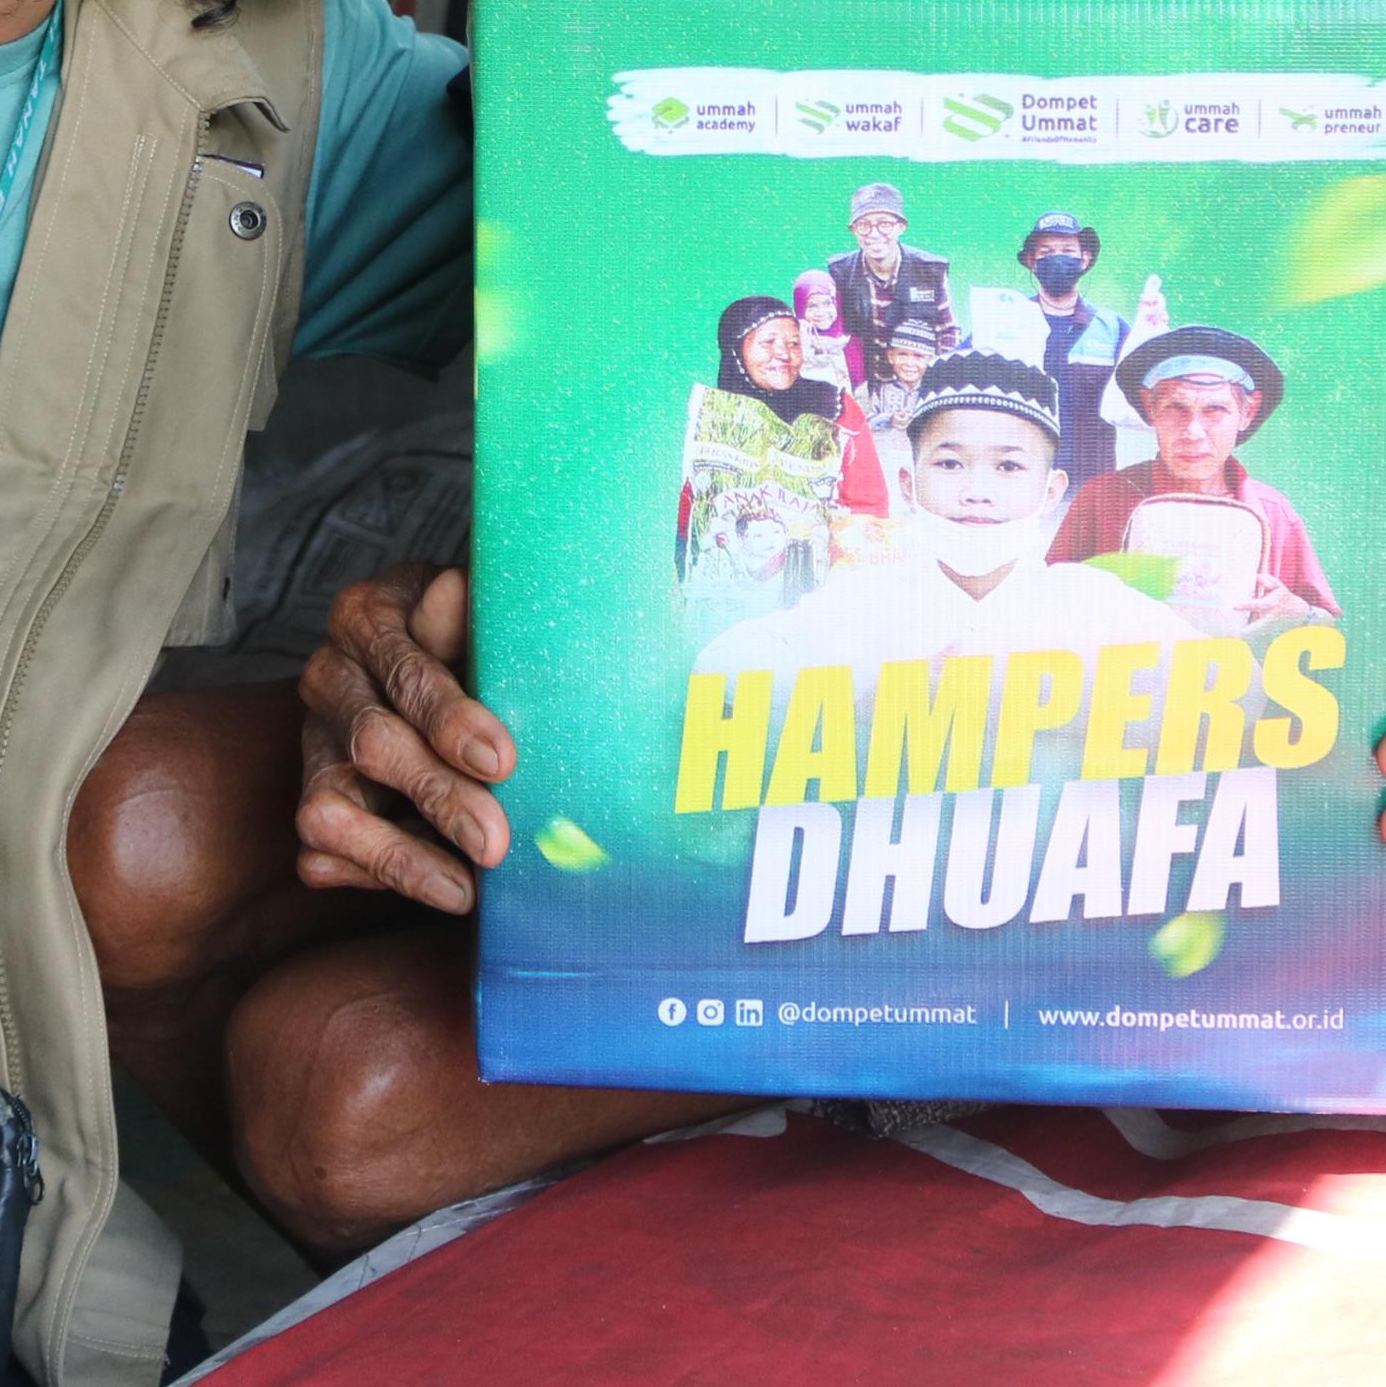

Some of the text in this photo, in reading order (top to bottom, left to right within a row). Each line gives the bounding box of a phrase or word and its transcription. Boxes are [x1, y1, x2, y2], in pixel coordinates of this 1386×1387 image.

[696, 100, 756, 116] ummah
[845, 100, 902, 115] ummah
[1021, 93, 1098, 112] Dompet
[1184, 102, 1240, 116] ummah
[1324, 105, 1382, 120] ummah
[696, 118, 756, 133] academy
[845, 115, 902, 132] wakaf
[1021, 115, 1098, 132] Ummat
[1184, 117, 1240, 134] care
[1324, 121, 1382, 136] preneur
[674, 624, 1346, 814] HAMPERS
[744, 766, 1281, 945] DHUAFA
[778, 1000, 977, 1027] @dompetummat
[1038, 1005, 1344, 1032] www.dompetummat.or.id
